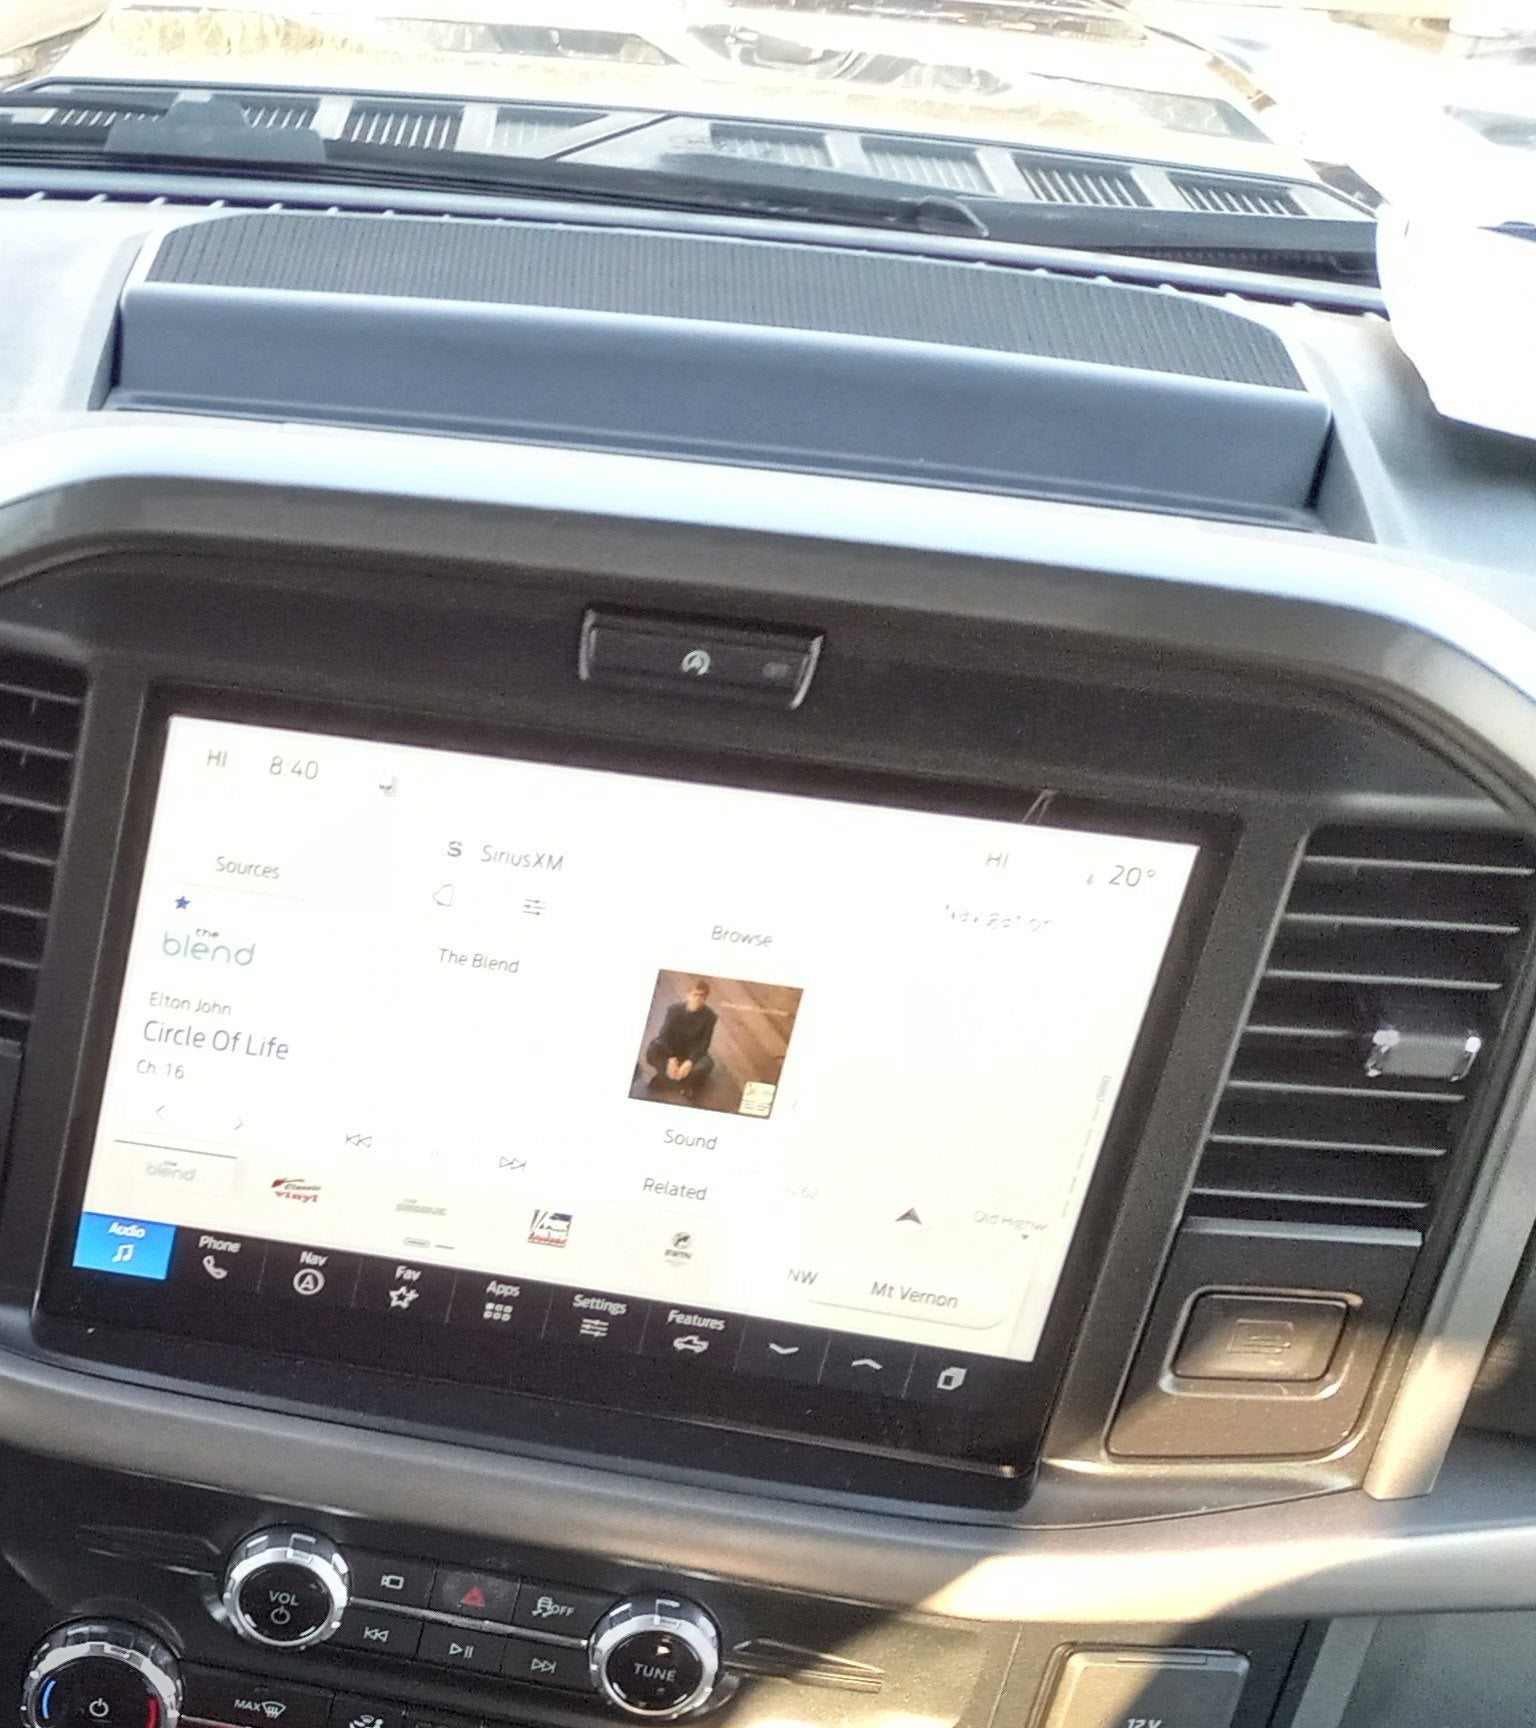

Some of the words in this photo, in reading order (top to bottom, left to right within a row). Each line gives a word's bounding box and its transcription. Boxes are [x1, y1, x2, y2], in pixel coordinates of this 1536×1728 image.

[215, 855, 281, 882] Sources
[480, 844, 564, 873] SiriusXM
[711, 924, 775, 949] Browse
[161, 931, 257, 968] blend
[438, 947, 468, 969] The
[471, 951, 520, 975] Blend
[148, 991, 192, 1013] Elton
[193, 997, 232, 1017] John
[142, 1019, 206, 1049] Circle
[211, 1028, 241, 1055] Of
[245, 1033, 290, 1061] Life
[165, 1062, 185, 1081] 16
[662, 1128, 719, 1152] Sound
[642, 1177, 708, 1202] Related
[108, 1221, 146, 1240] Audio
[198, 1234, 242, 1254] Phone
[299, 1250, 328, 1268] Nav
[394, 1265, 422, 1284] Fav
[787, 1268, 820, 1286] NW
[485, 1279, 521, 1300] Apps
[870, 1280, 899, 1301] Mt
[900, 1285, 959, 1309] Vernon
[572, 1294, 628, 1317] Settings
[666, 1309, 726, 1331] Features
[268, 1590, 300, 1608] VOL
[549, 1602, 576, 1618] OFF
[633, 1663, 676, 1683] TUNE
[234, 1698, 262, 1713] MAX
